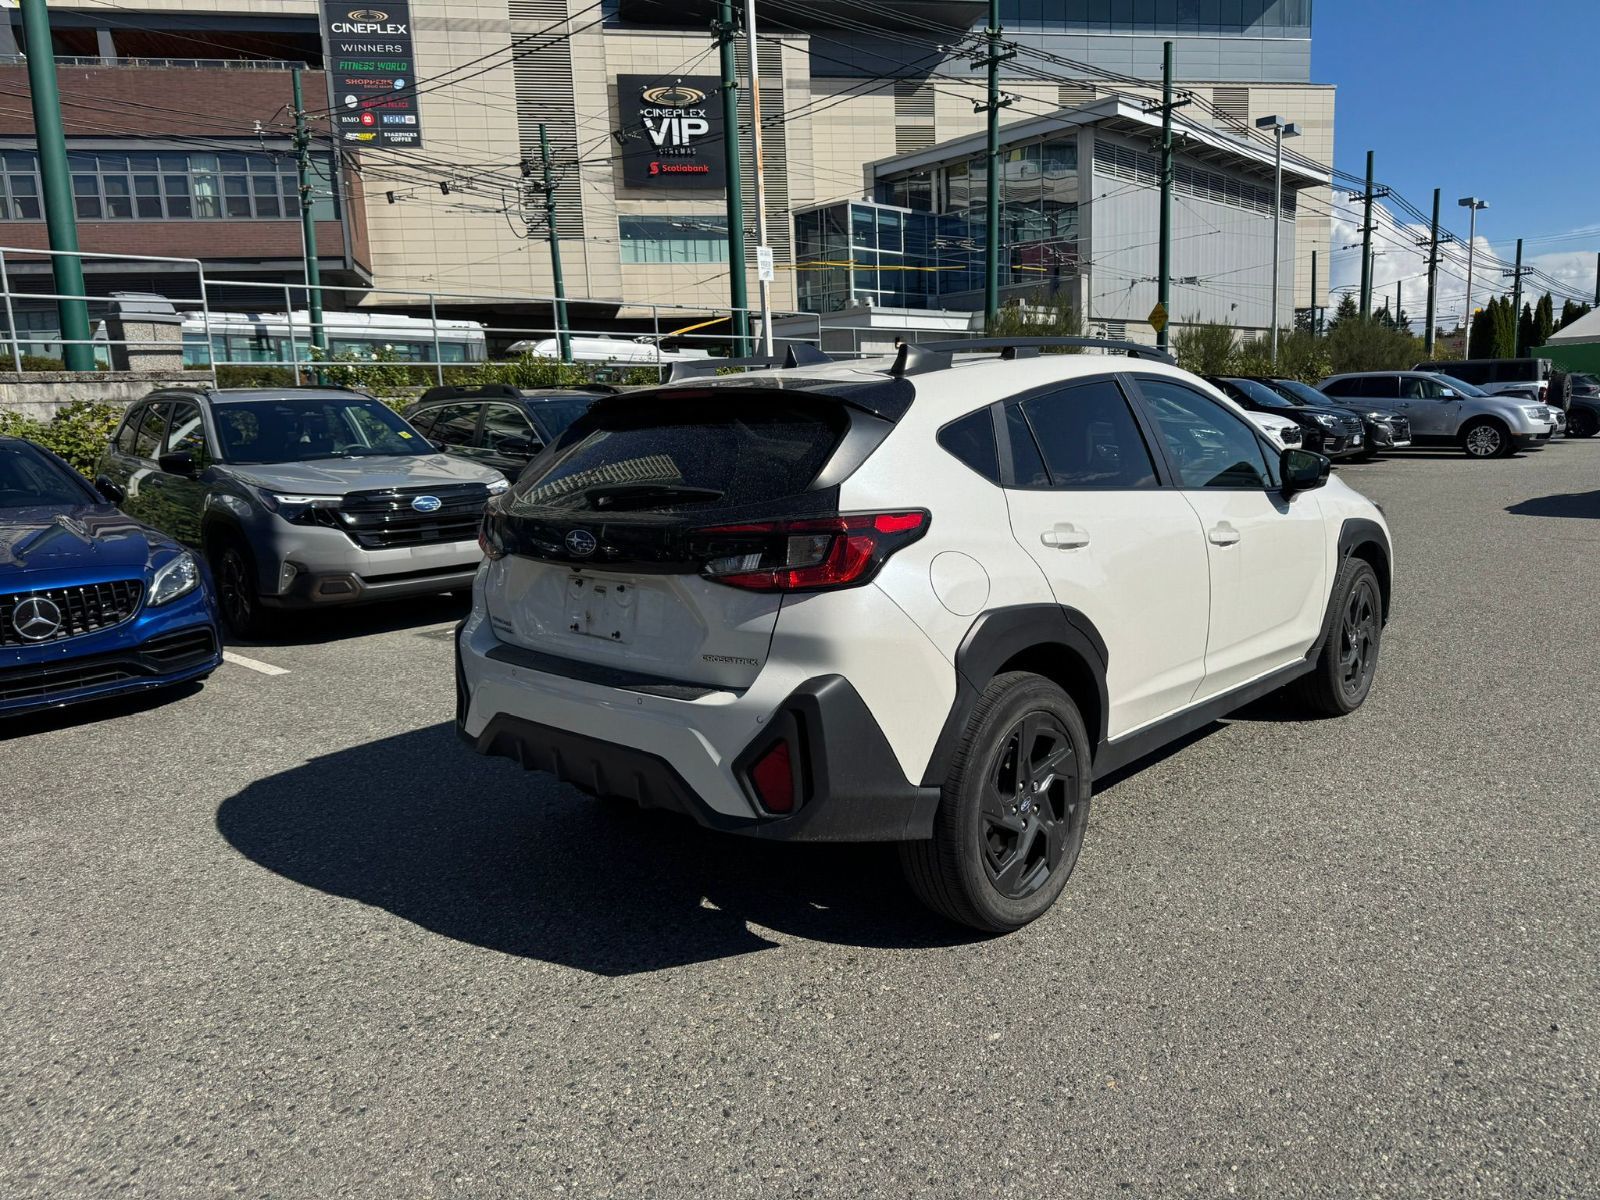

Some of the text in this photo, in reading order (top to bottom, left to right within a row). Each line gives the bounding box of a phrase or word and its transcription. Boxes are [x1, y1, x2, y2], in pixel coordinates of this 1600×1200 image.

[331, 23, 407, 34] CINEPLEX
[341, 44, 403, 53] WINNERS
[339, 61, 408, 72] FITNESS WORLD
[644, 108, 706, 117] CINEPLEX
[341, 116, 360, 124] BMO
[643, 118, 709, 146] VIP
[662, 164, 709, 172] Scotiabank
[702, 655, 758, 666] CROSSTREK
